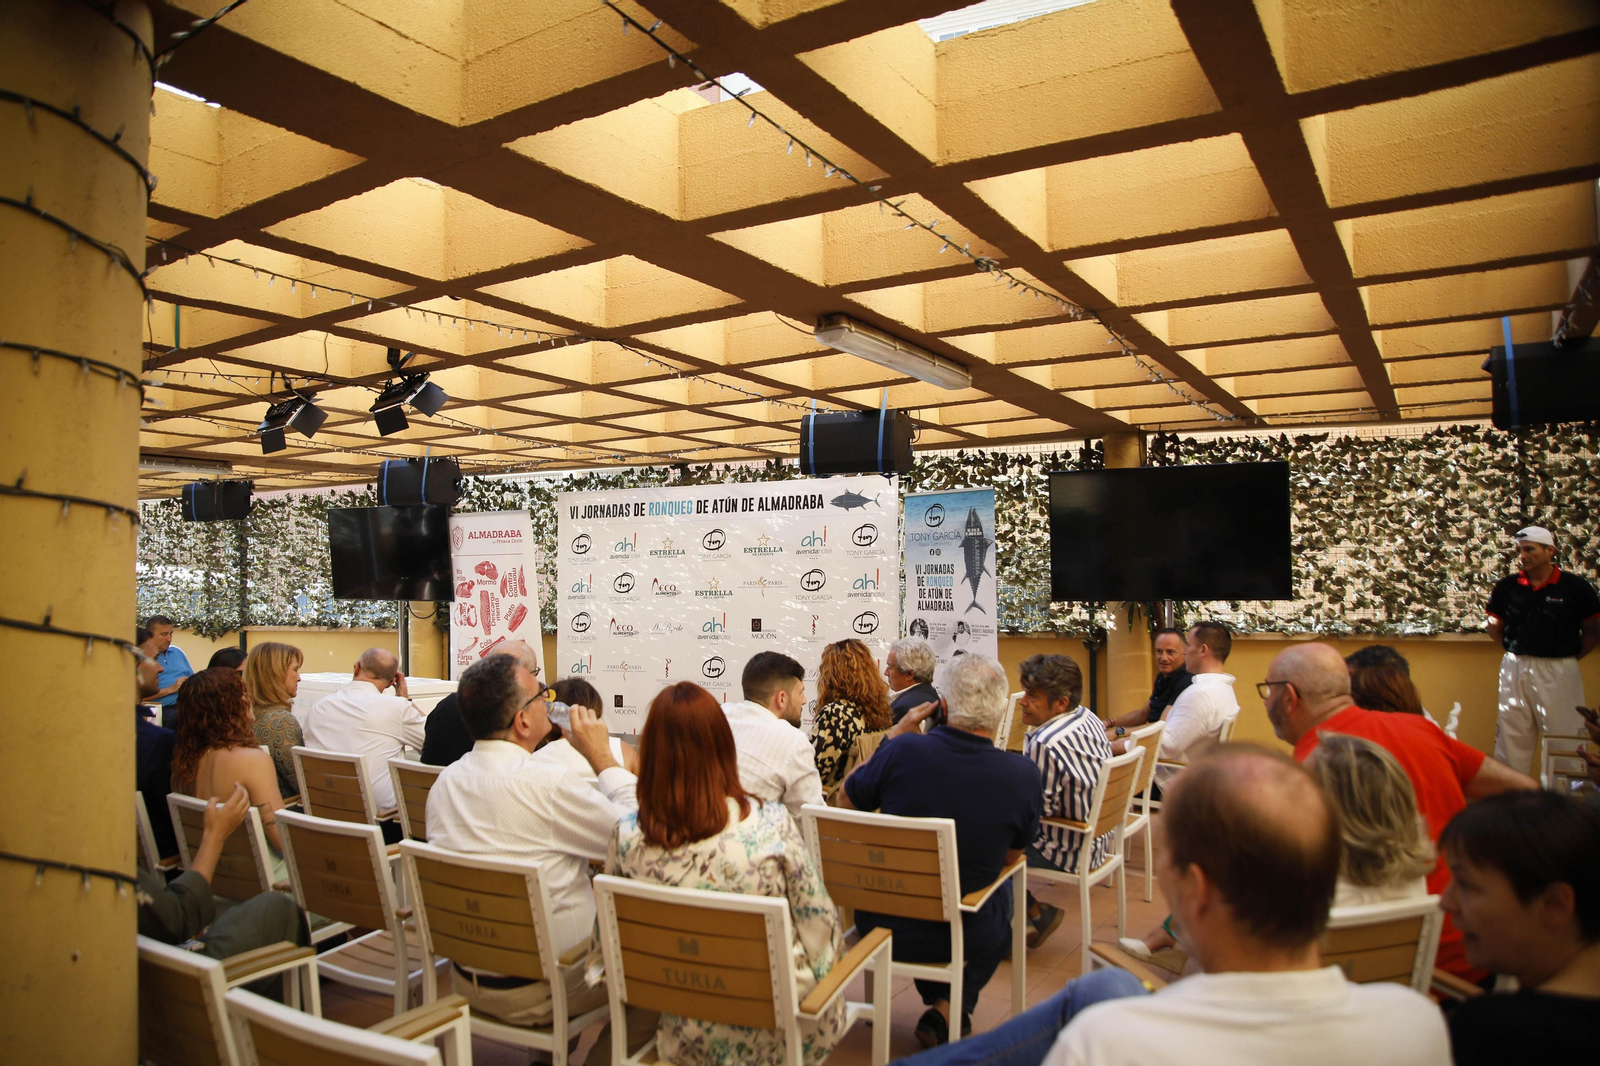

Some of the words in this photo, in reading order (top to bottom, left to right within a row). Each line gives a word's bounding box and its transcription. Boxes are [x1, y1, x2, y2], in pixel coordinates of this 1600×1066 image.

[570, 506, 578, 519] VI
[582, 503, 630, 519] JORNADAS
[634, 502, 645, 516] DE
[649, 500, 692, 517] RONQUEO
[696, 500, 708, 514] DE
[712, 496, 738, 513] ATÚN
[742, 497, 754, 512] DE
[758, 494, 824, 511] ALMADRABA
[468, 530, 522, 539] ALMADRABA
[614, 532, 636, 552] ah!
[801, 526, 826, 547] ah!
[911, 533, 931, 542] TONY
[933, 529, 961, 540] GARCÍA
[853, 568, 879, 590] ah!
[915, 564, 922, 575] VI
[923, 564, 954, 575] JORNADAS
[571, 574, 592, 593] ah!
[917, 576, 924, 587] DE
[926, 576, 953, 588] RONQUEO
[918, 589, 926, 599] DE
[928, 587, 943, 599] ATÚN
[945, 589, 952, 599] DE
[504, 604, 515, 621] Plato
[917, 601, 954, 611] ALMADRABA
[702, 612, 726, 632] ah!
[480, 638, 492, 648] Cola
[571, 655, 592, 674] ah!
[319, 880, 352, 896] TURIA
[855, 873, 906, 892] TURIA
[458, 921, 499, 940] TURIA
[663, 967, 727, 990] TURIA
